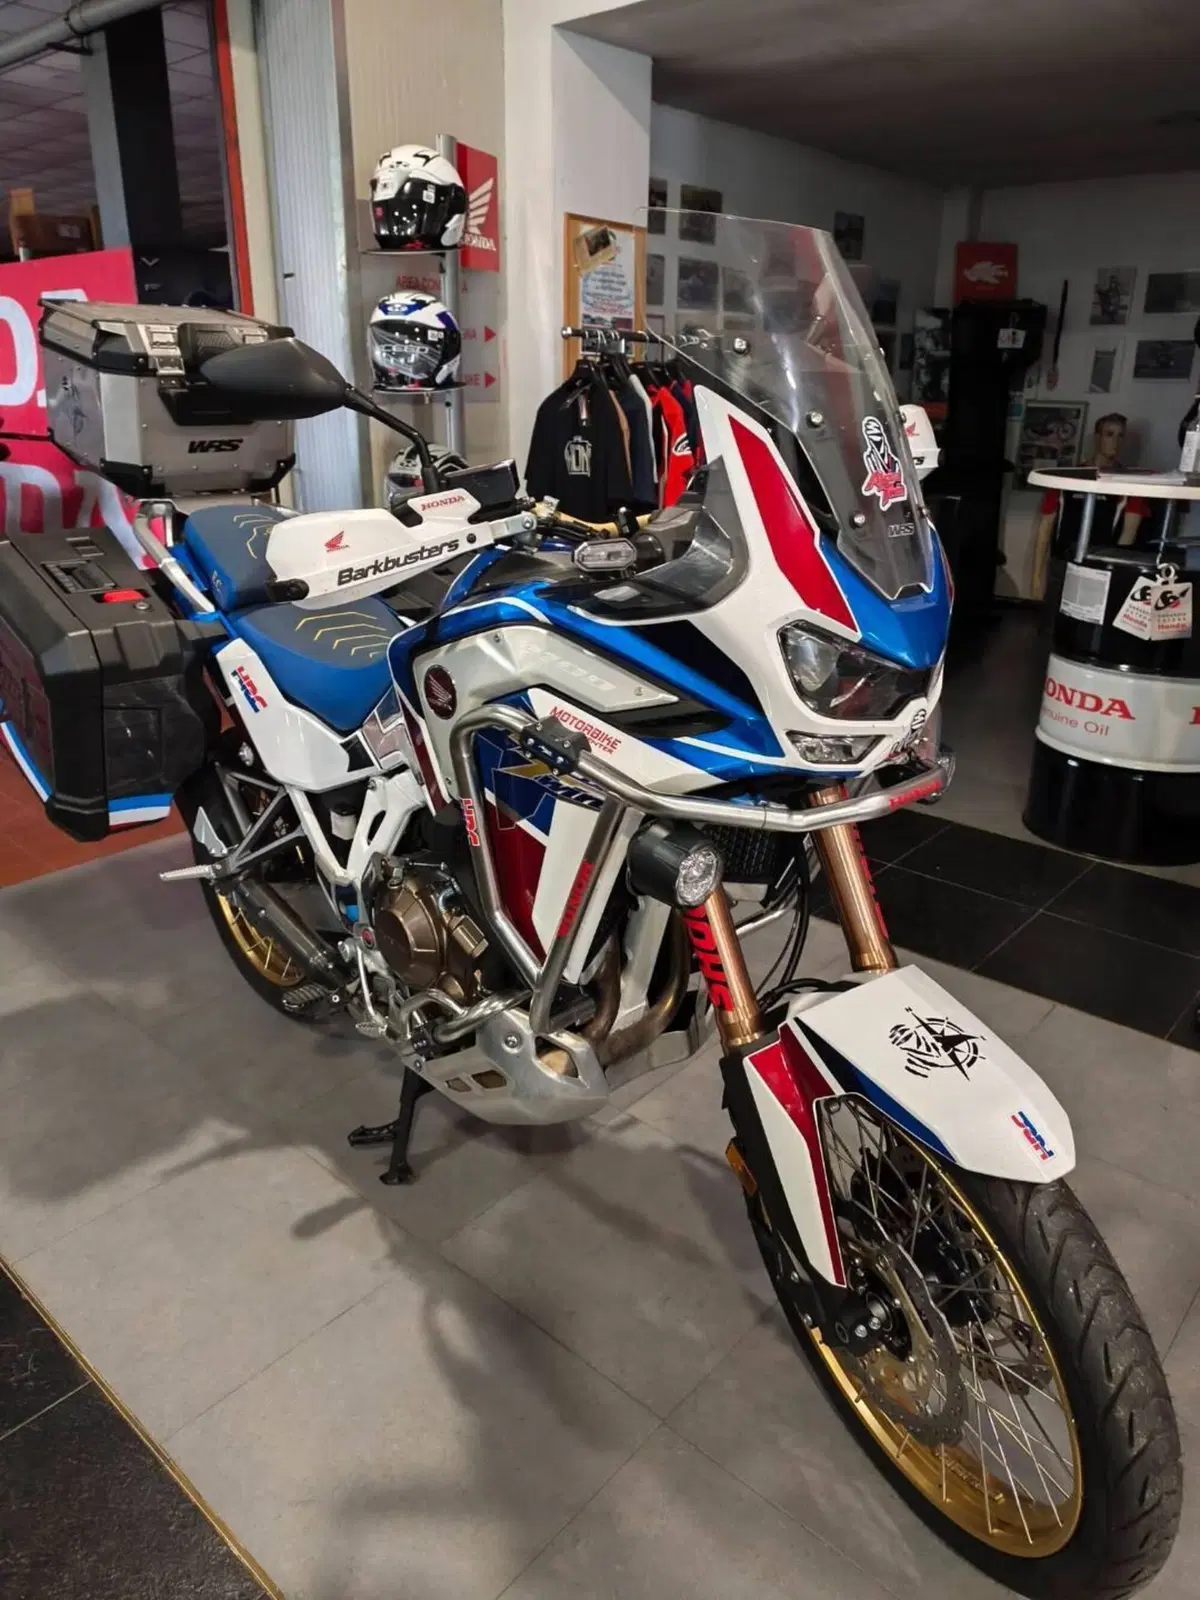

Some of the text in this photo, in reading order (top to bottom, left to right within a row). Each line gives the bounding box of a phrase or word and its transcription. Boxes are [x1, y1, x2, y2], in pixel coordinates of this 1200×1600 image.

[187, 437, 244, 454] WRS
[421, 494, 466, 512] HONDA
[336, 538, 460, 588] Barkbusters
[230, 664, 269, 714] HRC
[548, 705, 622, 751] MOTORBIKE
[1083, 720, 1110, 737] Oil
[1010, 1110, 1055, 1162] HRC
